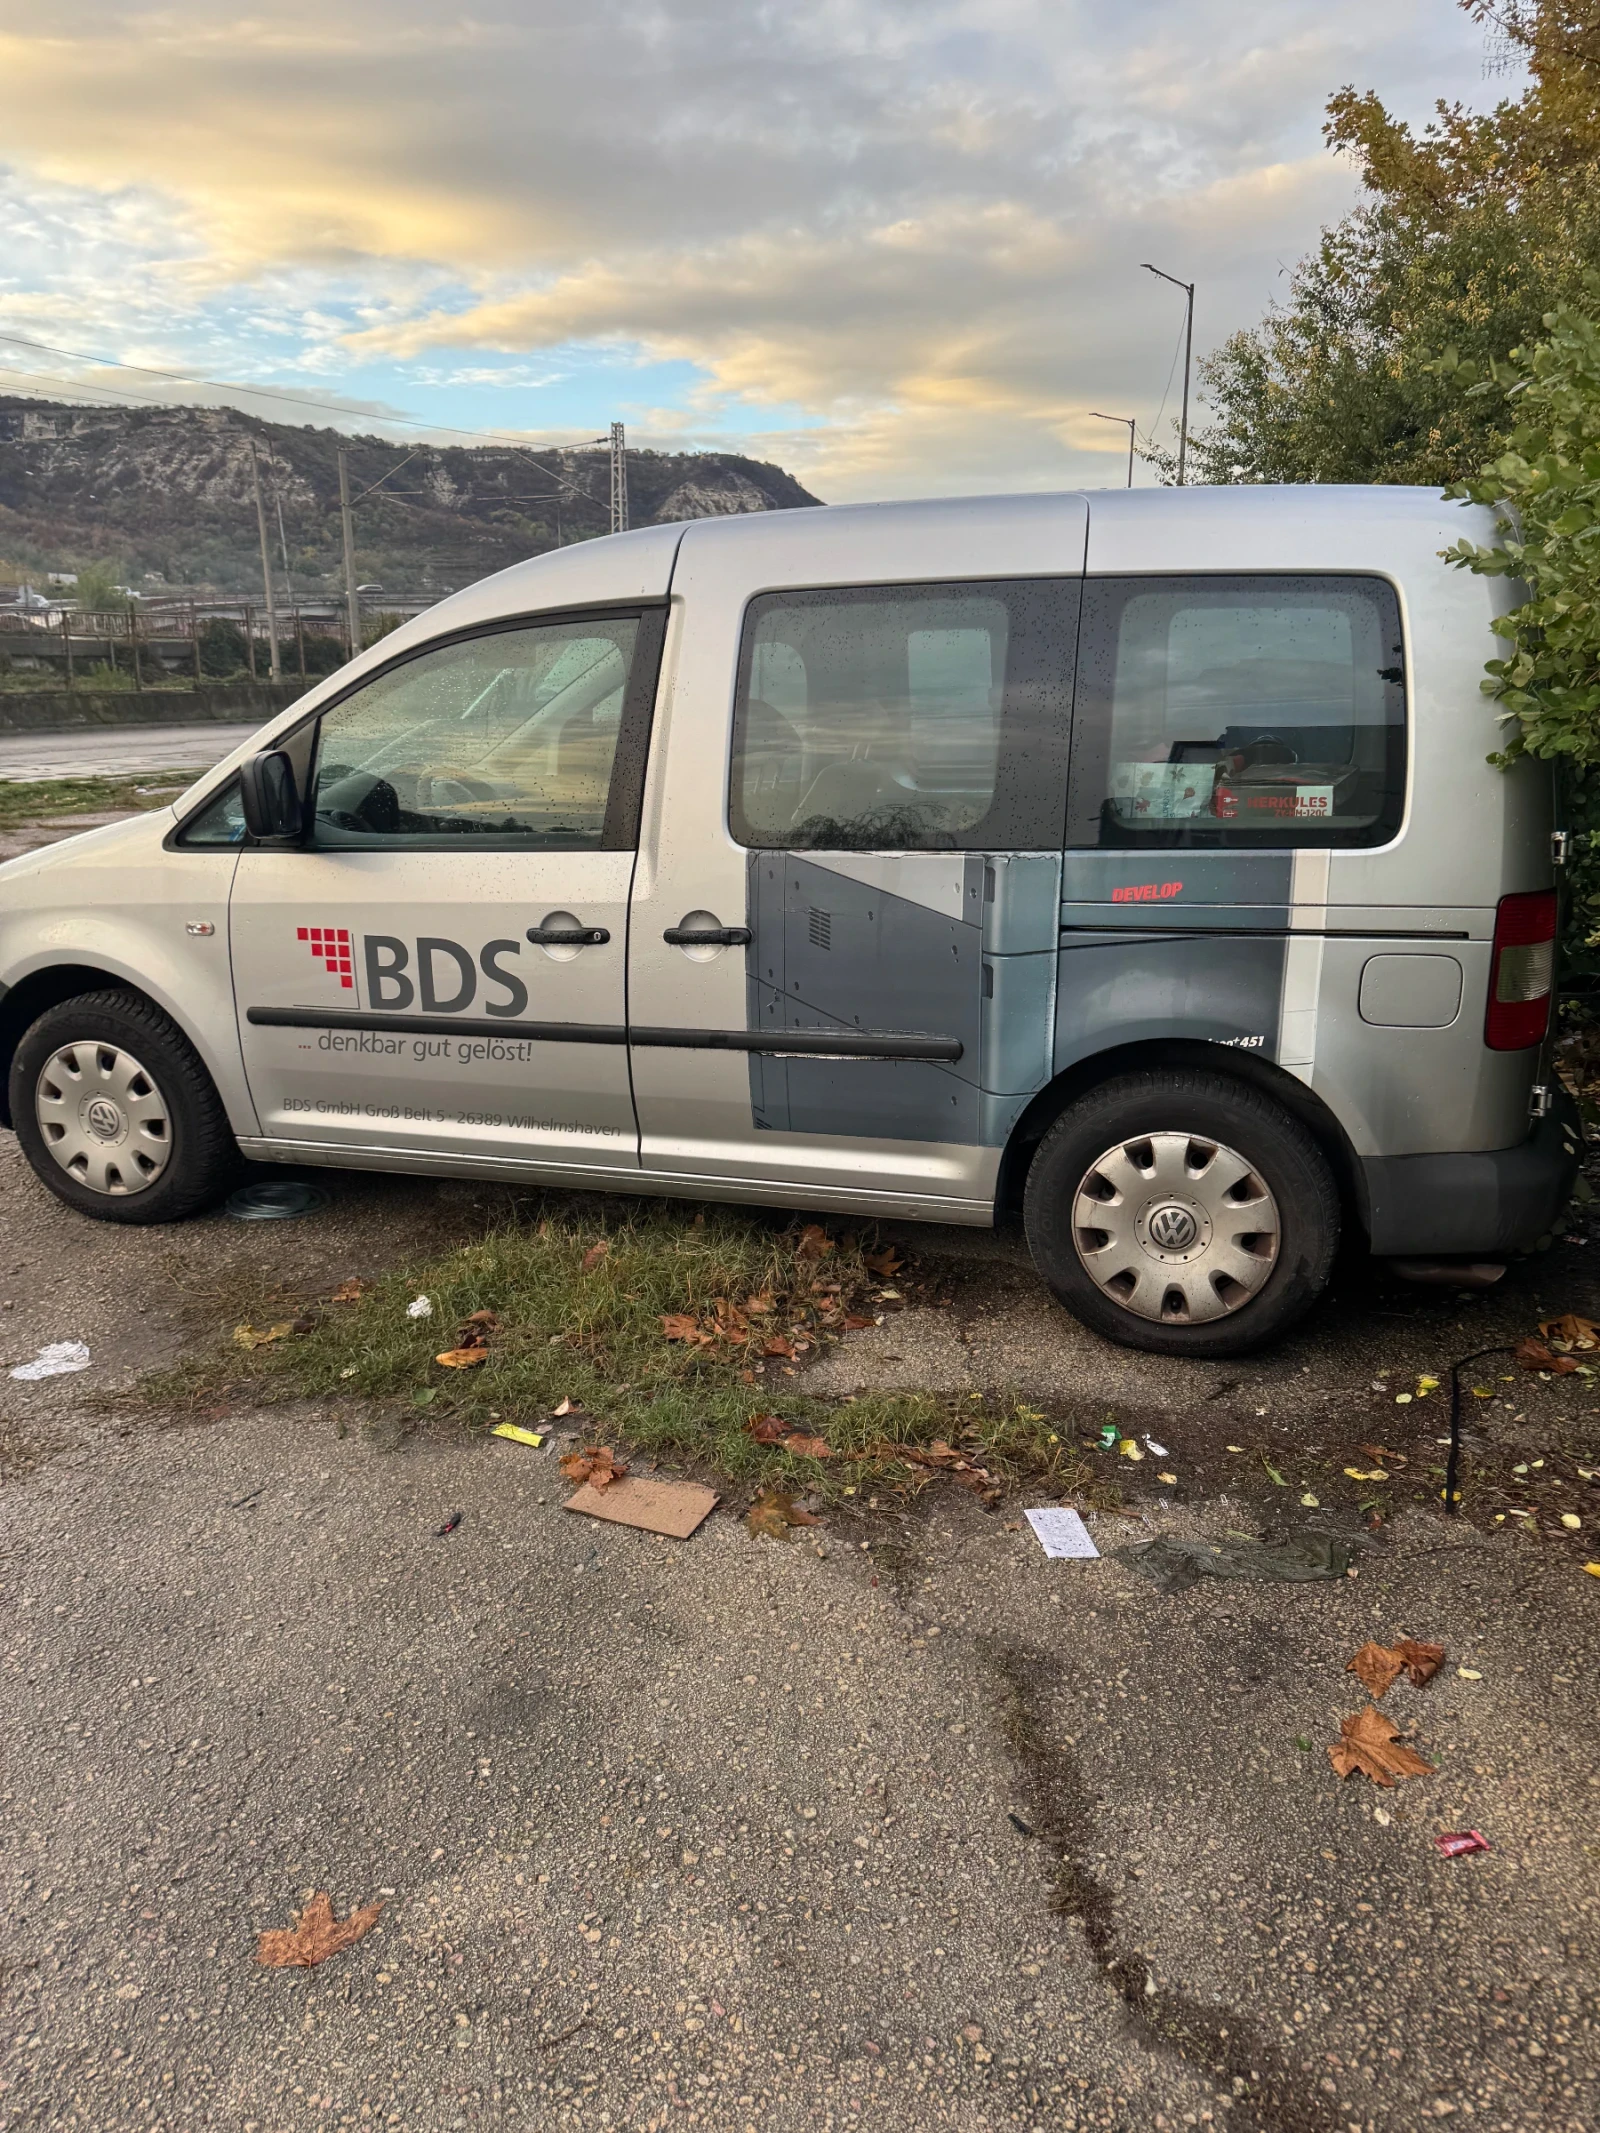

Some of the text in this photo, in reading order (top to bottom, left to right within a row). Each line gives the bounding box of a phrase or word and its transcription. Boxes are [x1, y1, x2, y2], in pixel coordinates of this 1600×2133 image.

[1247, 796, 1328, 808] HERKULES
[1112, 881, 1183, 903] DEVELOP
[363, 934, 528, 1018] BDS
[318, 1030, 407, 1055] denkbar
[413, 1038, 451, 1062] gut
[458, 1039, 533, 1065] gelöst!
[283, 1098, 311, 1112] BDS
[316, 1100, 360, 1116] GmbH
[365, 1104, 400, 1119] Groß
[404, 1107, 432, 1121] Belt
[436, 1109, 445, 1122] 5
[457, 1111, 502, 1126] 26389
[507, 1115, 621, 1137] Wilhelmshaven
